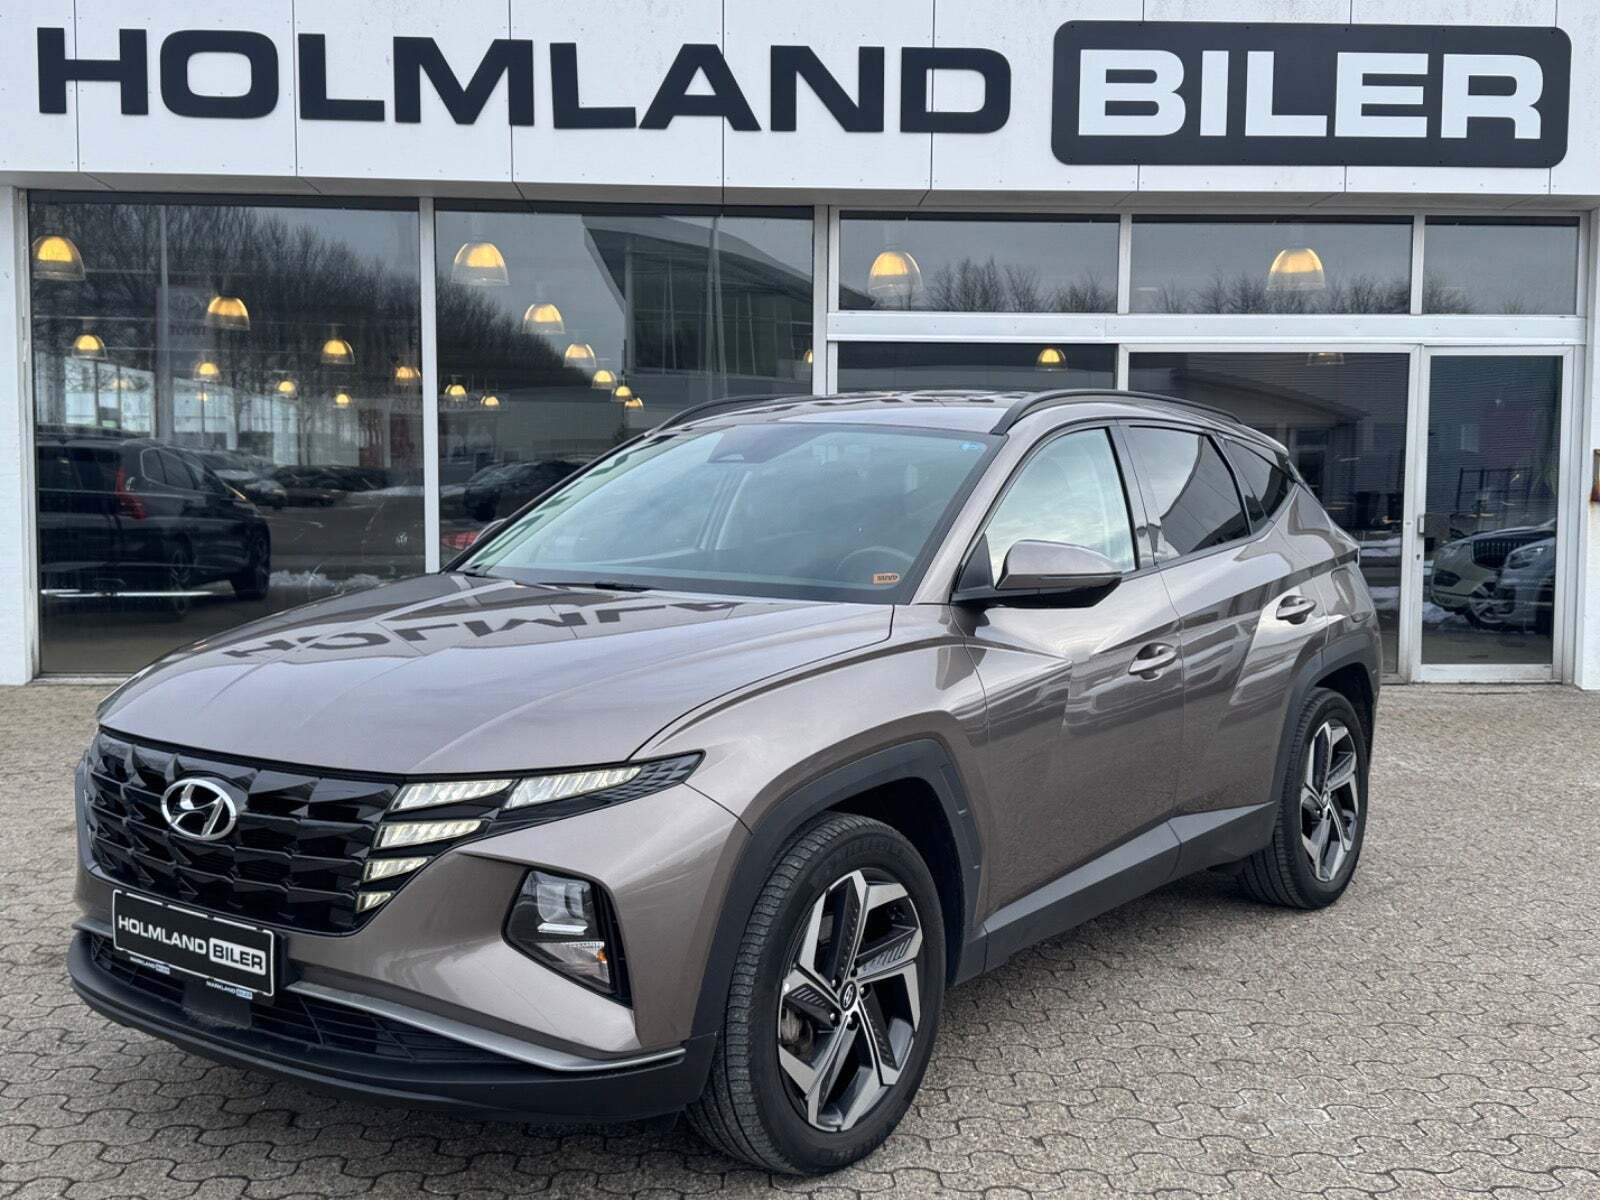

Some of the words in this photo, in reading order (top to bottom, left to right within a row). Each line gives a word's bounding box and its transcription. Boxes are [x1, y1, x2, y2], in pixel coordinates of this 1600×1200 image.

[37, 27, 1012, 134] HOLMLAND
[1078, 48, 1544, 140] BILER
[118, 915, 207, 955] HOLMLAND
[212, 943, 264, 971] BILER
